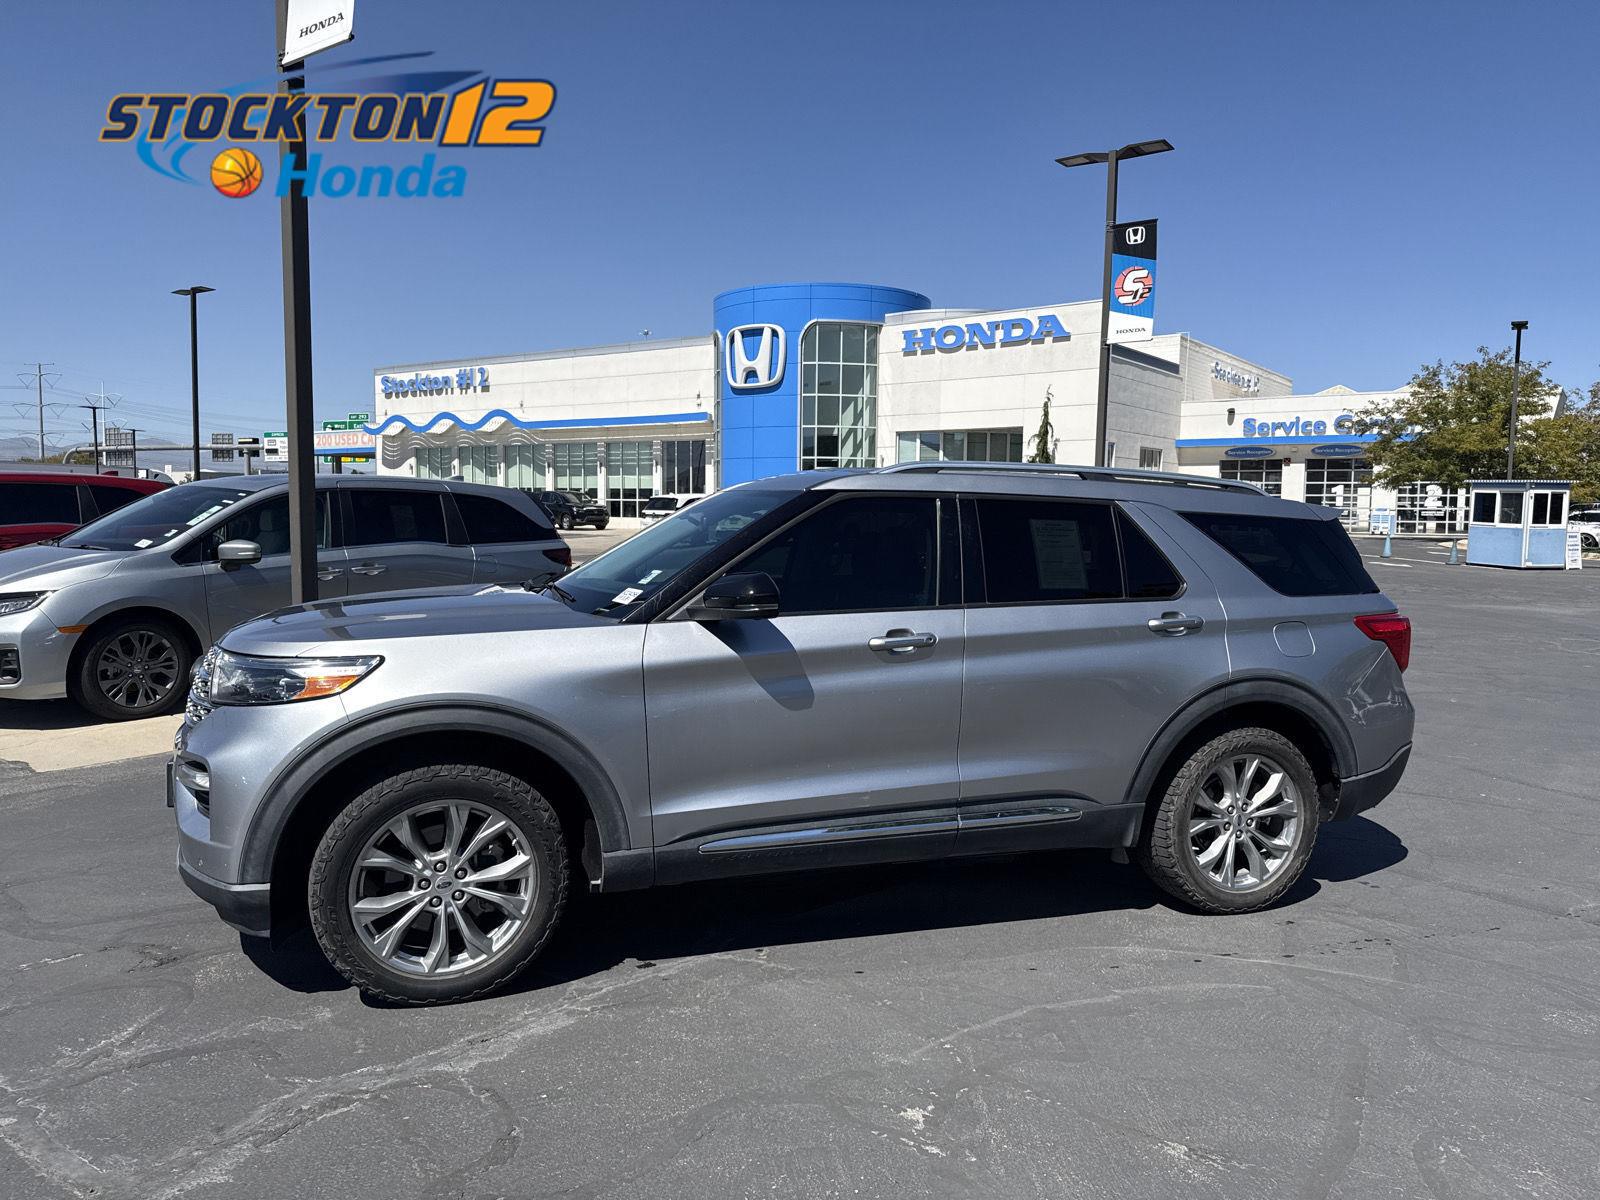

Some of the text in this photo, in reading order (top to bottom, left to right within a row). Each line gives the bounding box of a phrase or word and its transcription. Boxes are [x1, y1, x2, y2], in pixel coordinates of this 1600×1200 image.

[299, 12, 344, 38] HONDA
[902, 314, 1071, 353] HONDA
[1115, 327, 1147, 335] HONDA
[381, 367, 491, 394] Stockton #12
[1243, 416, 1327, 437] Service
[316, 435, 333, 447] 200
[334, 433, 359, 446] USED
[1331, 484, 1345, 507] 1
[1424, 484, 1443, 507] 2
